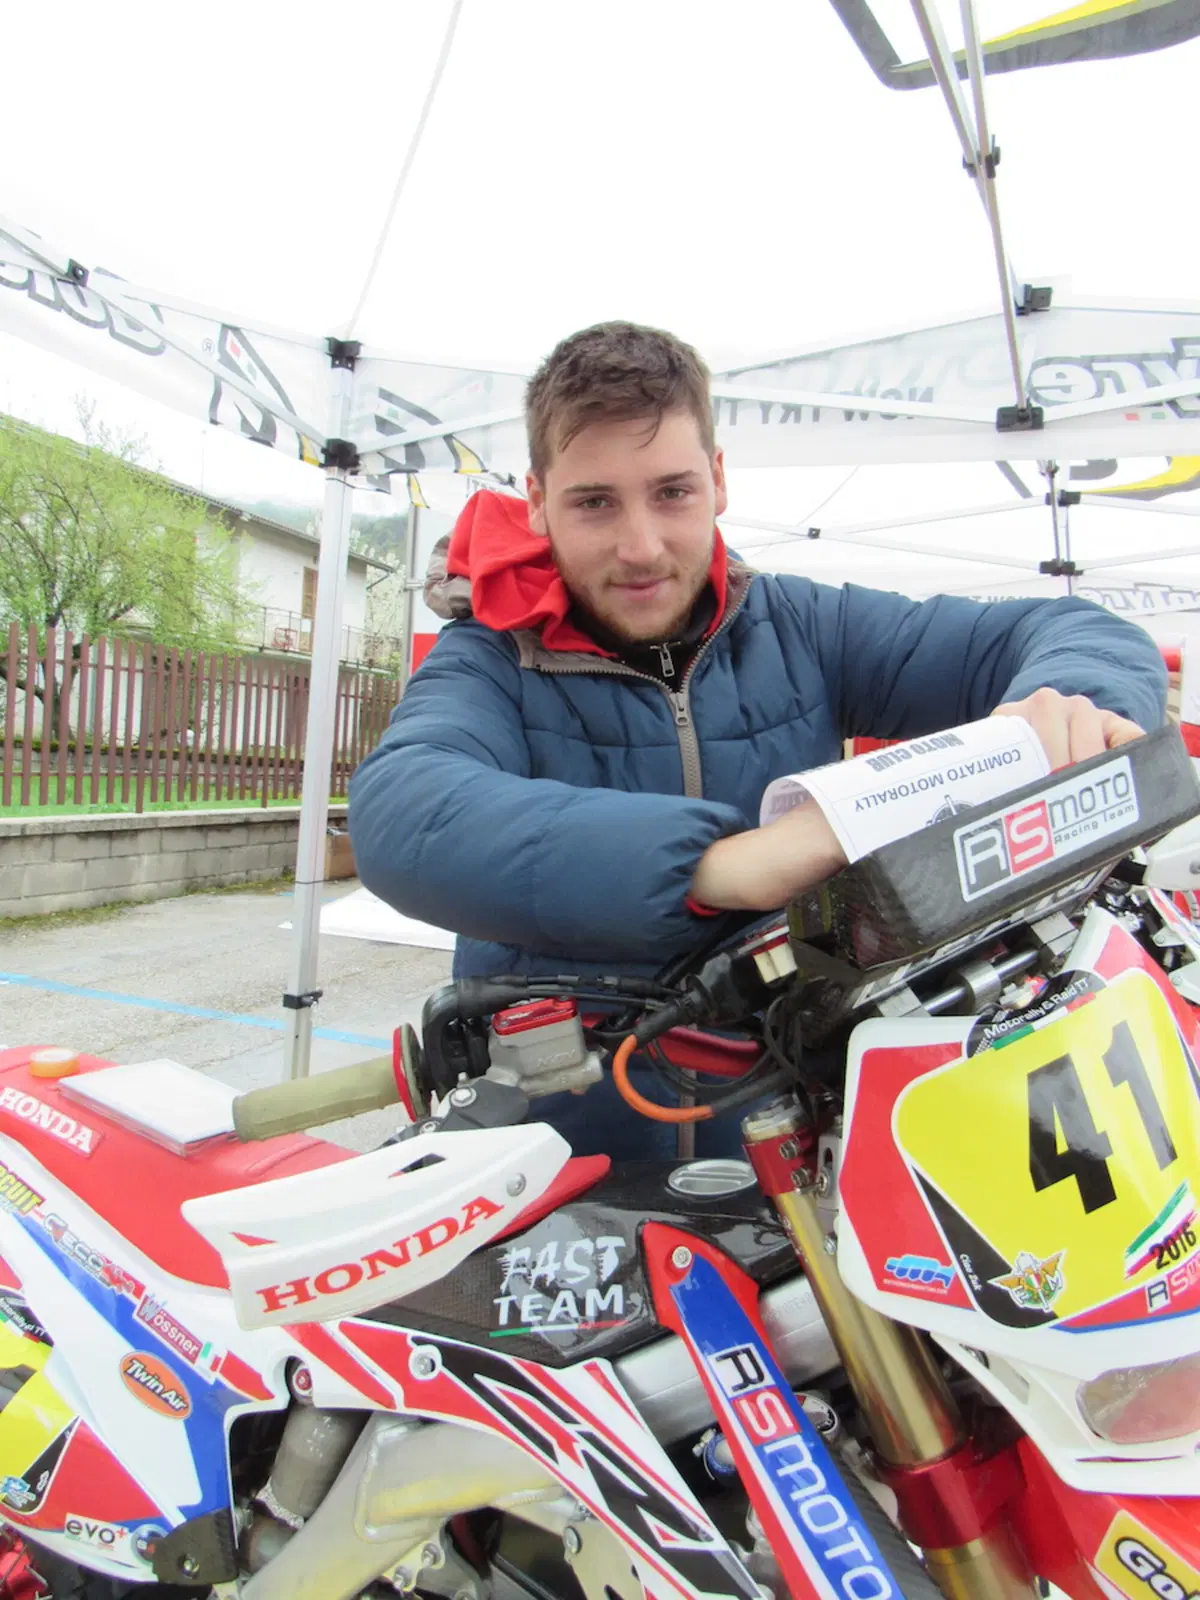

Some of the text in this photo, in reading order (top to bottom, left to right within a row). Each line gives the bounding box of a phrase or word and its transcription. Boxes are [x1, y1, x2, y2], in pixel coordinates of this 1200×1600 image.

[865, 733, 965, 773] MOTO CLUB
[946, 748, 1022, 781] COMITATO
[855, 770, 945, 813] MOTORALLY
[984, 1006, 1046, 1039] Motorally
[1052, 982, 1077, 1005] Raid
[0, 1086, 97, 1155] HONDA
[1027, 1020, 1178, 1215] 41
[257, 1196, 504, 1313] HONDA
[496, 1236, 626, 1291] FAST
[1149, 1221, 1197, 1270] 2016
[493, 1284, 625, 1326] TEAM
[126, 1359, 188, 1411] Twin Air
